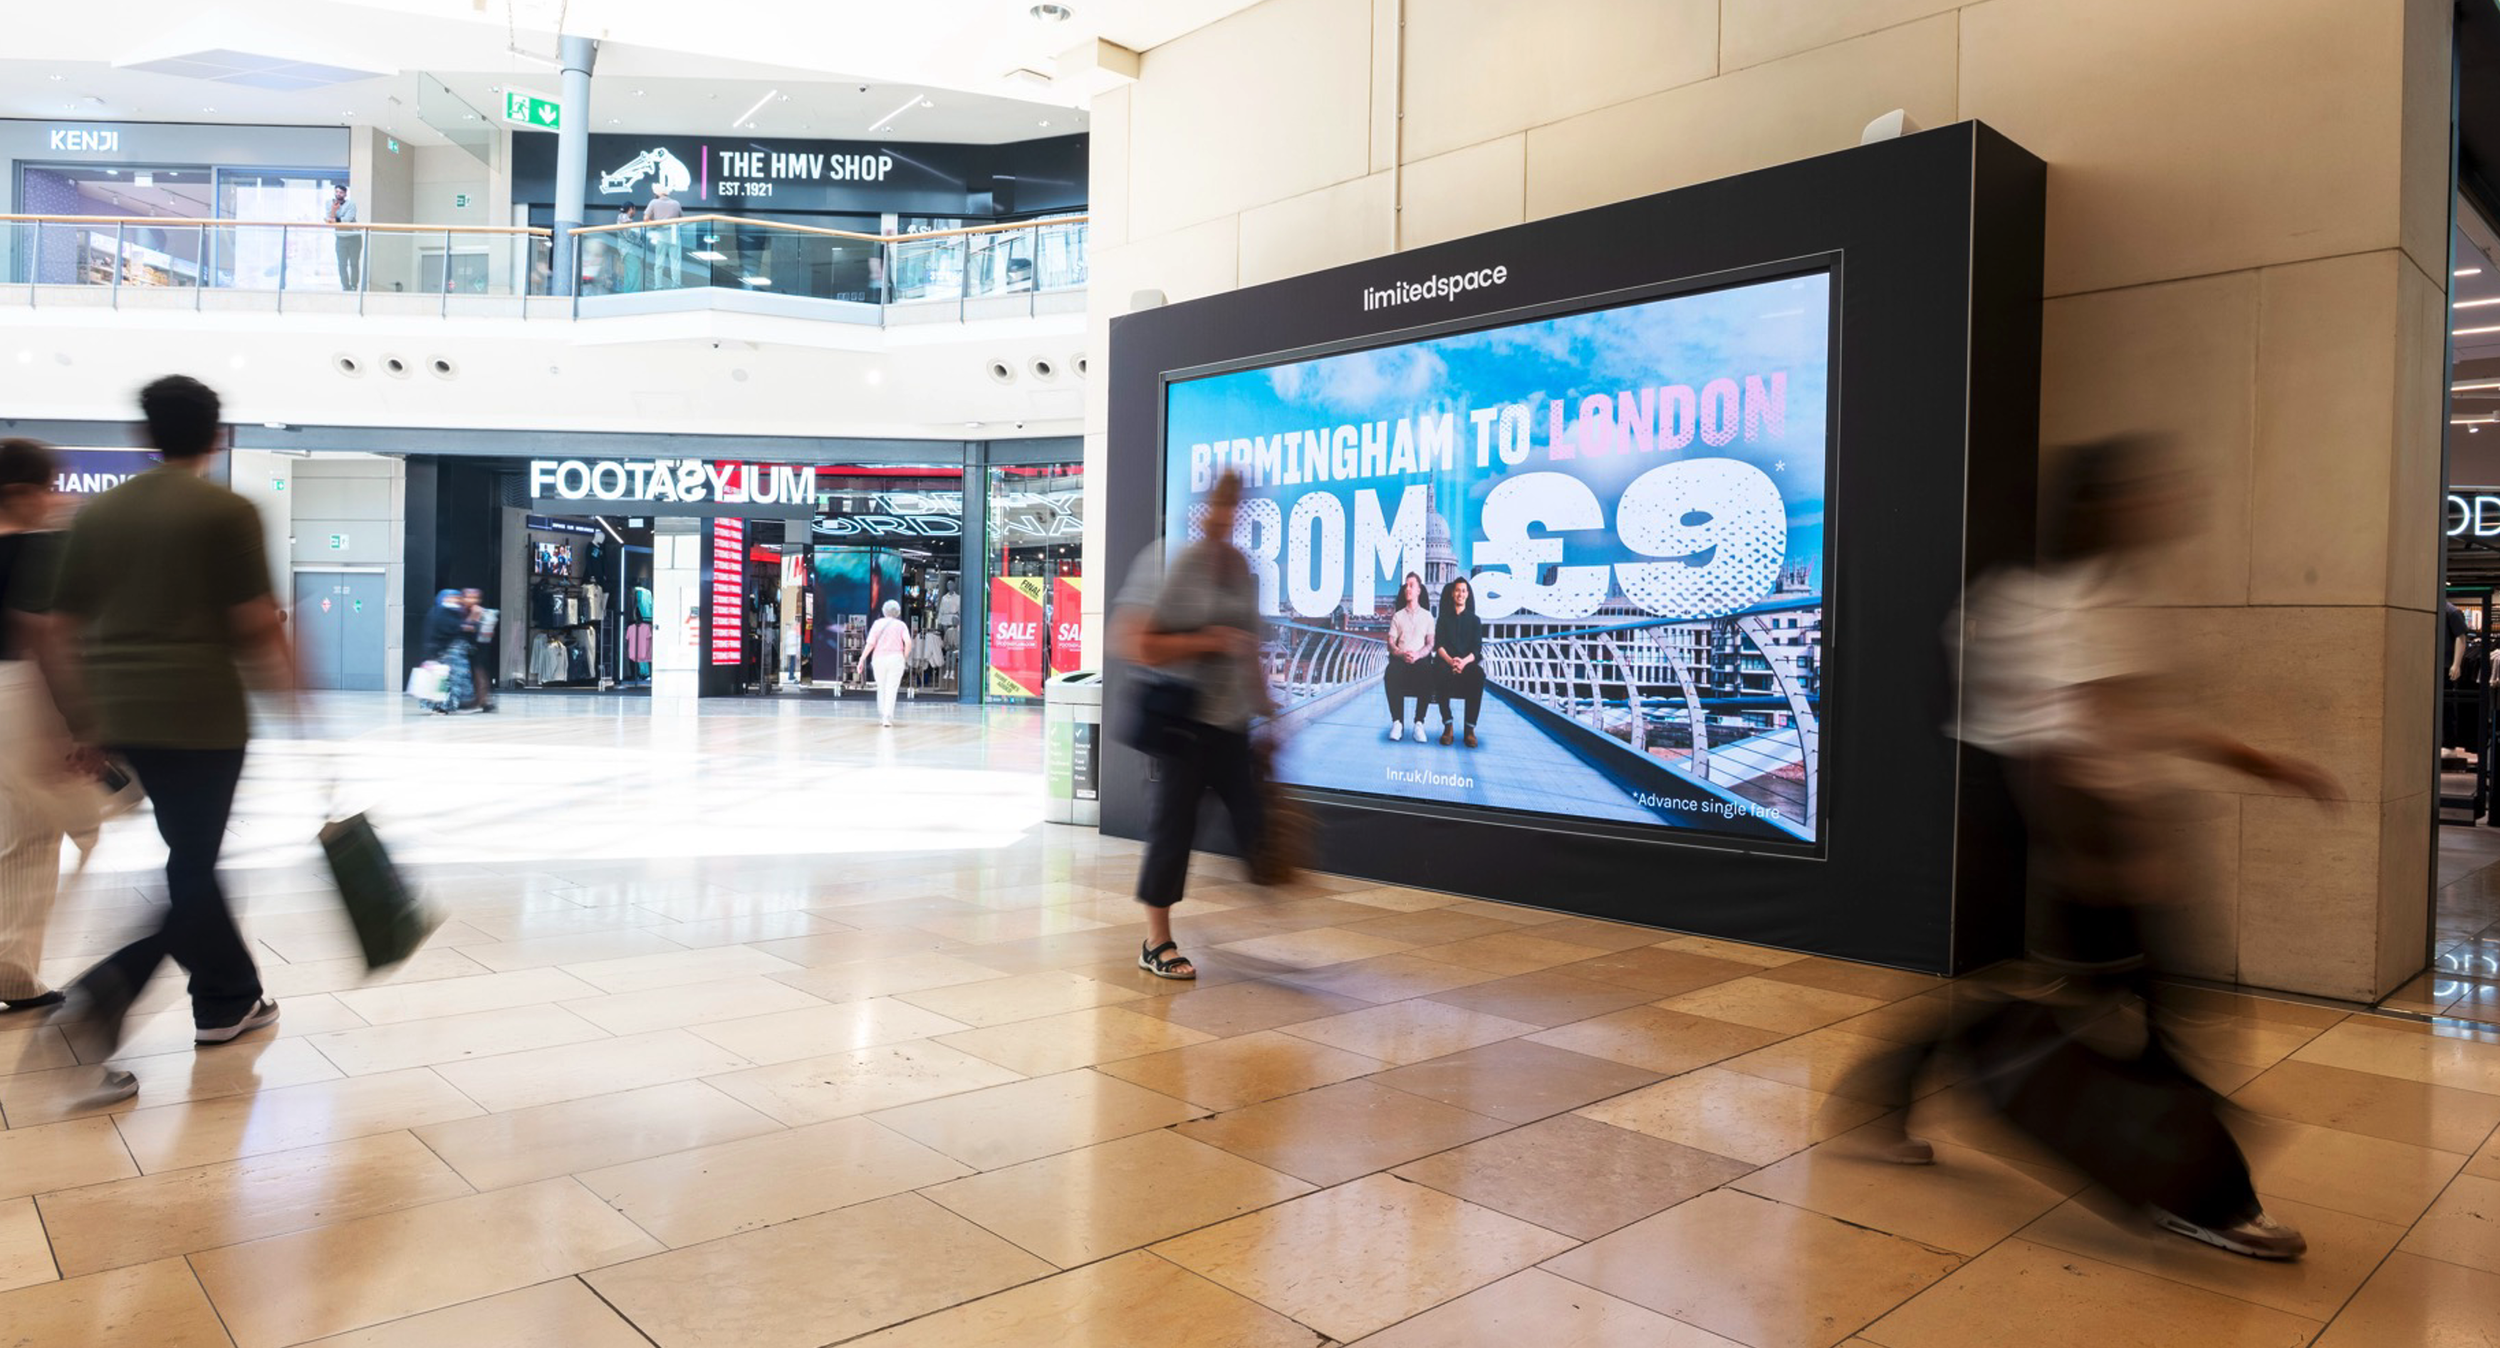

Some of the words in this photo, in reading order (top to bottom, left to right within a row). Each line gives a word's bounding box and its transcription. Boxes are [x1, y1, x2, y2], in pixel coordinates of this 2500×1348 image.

[50, 129, 119, 152] KENJI
[719, 151, 765, 178] THE
[771, 153, 824, 179] HMV
[830, 154, 893, 181] SHOP
[1363, 265, 1508, 312] limitedspace
[1190, 412, 1455, 493] BIRMINGHAM
[1470, 402, 1532, 470] TO
[1549, 370, 1789, 462] LONDON
[530, 460, 816, 505] FOOTASYLUM
[996, 620, 1037, 640] SALE
[1057, 623, 1081, 641] SA
[1386, 766, 1474, 789] lnr.uk/london
[1701, 799, 1746, 819] single
[1751, 803, 1780, 819] fare
